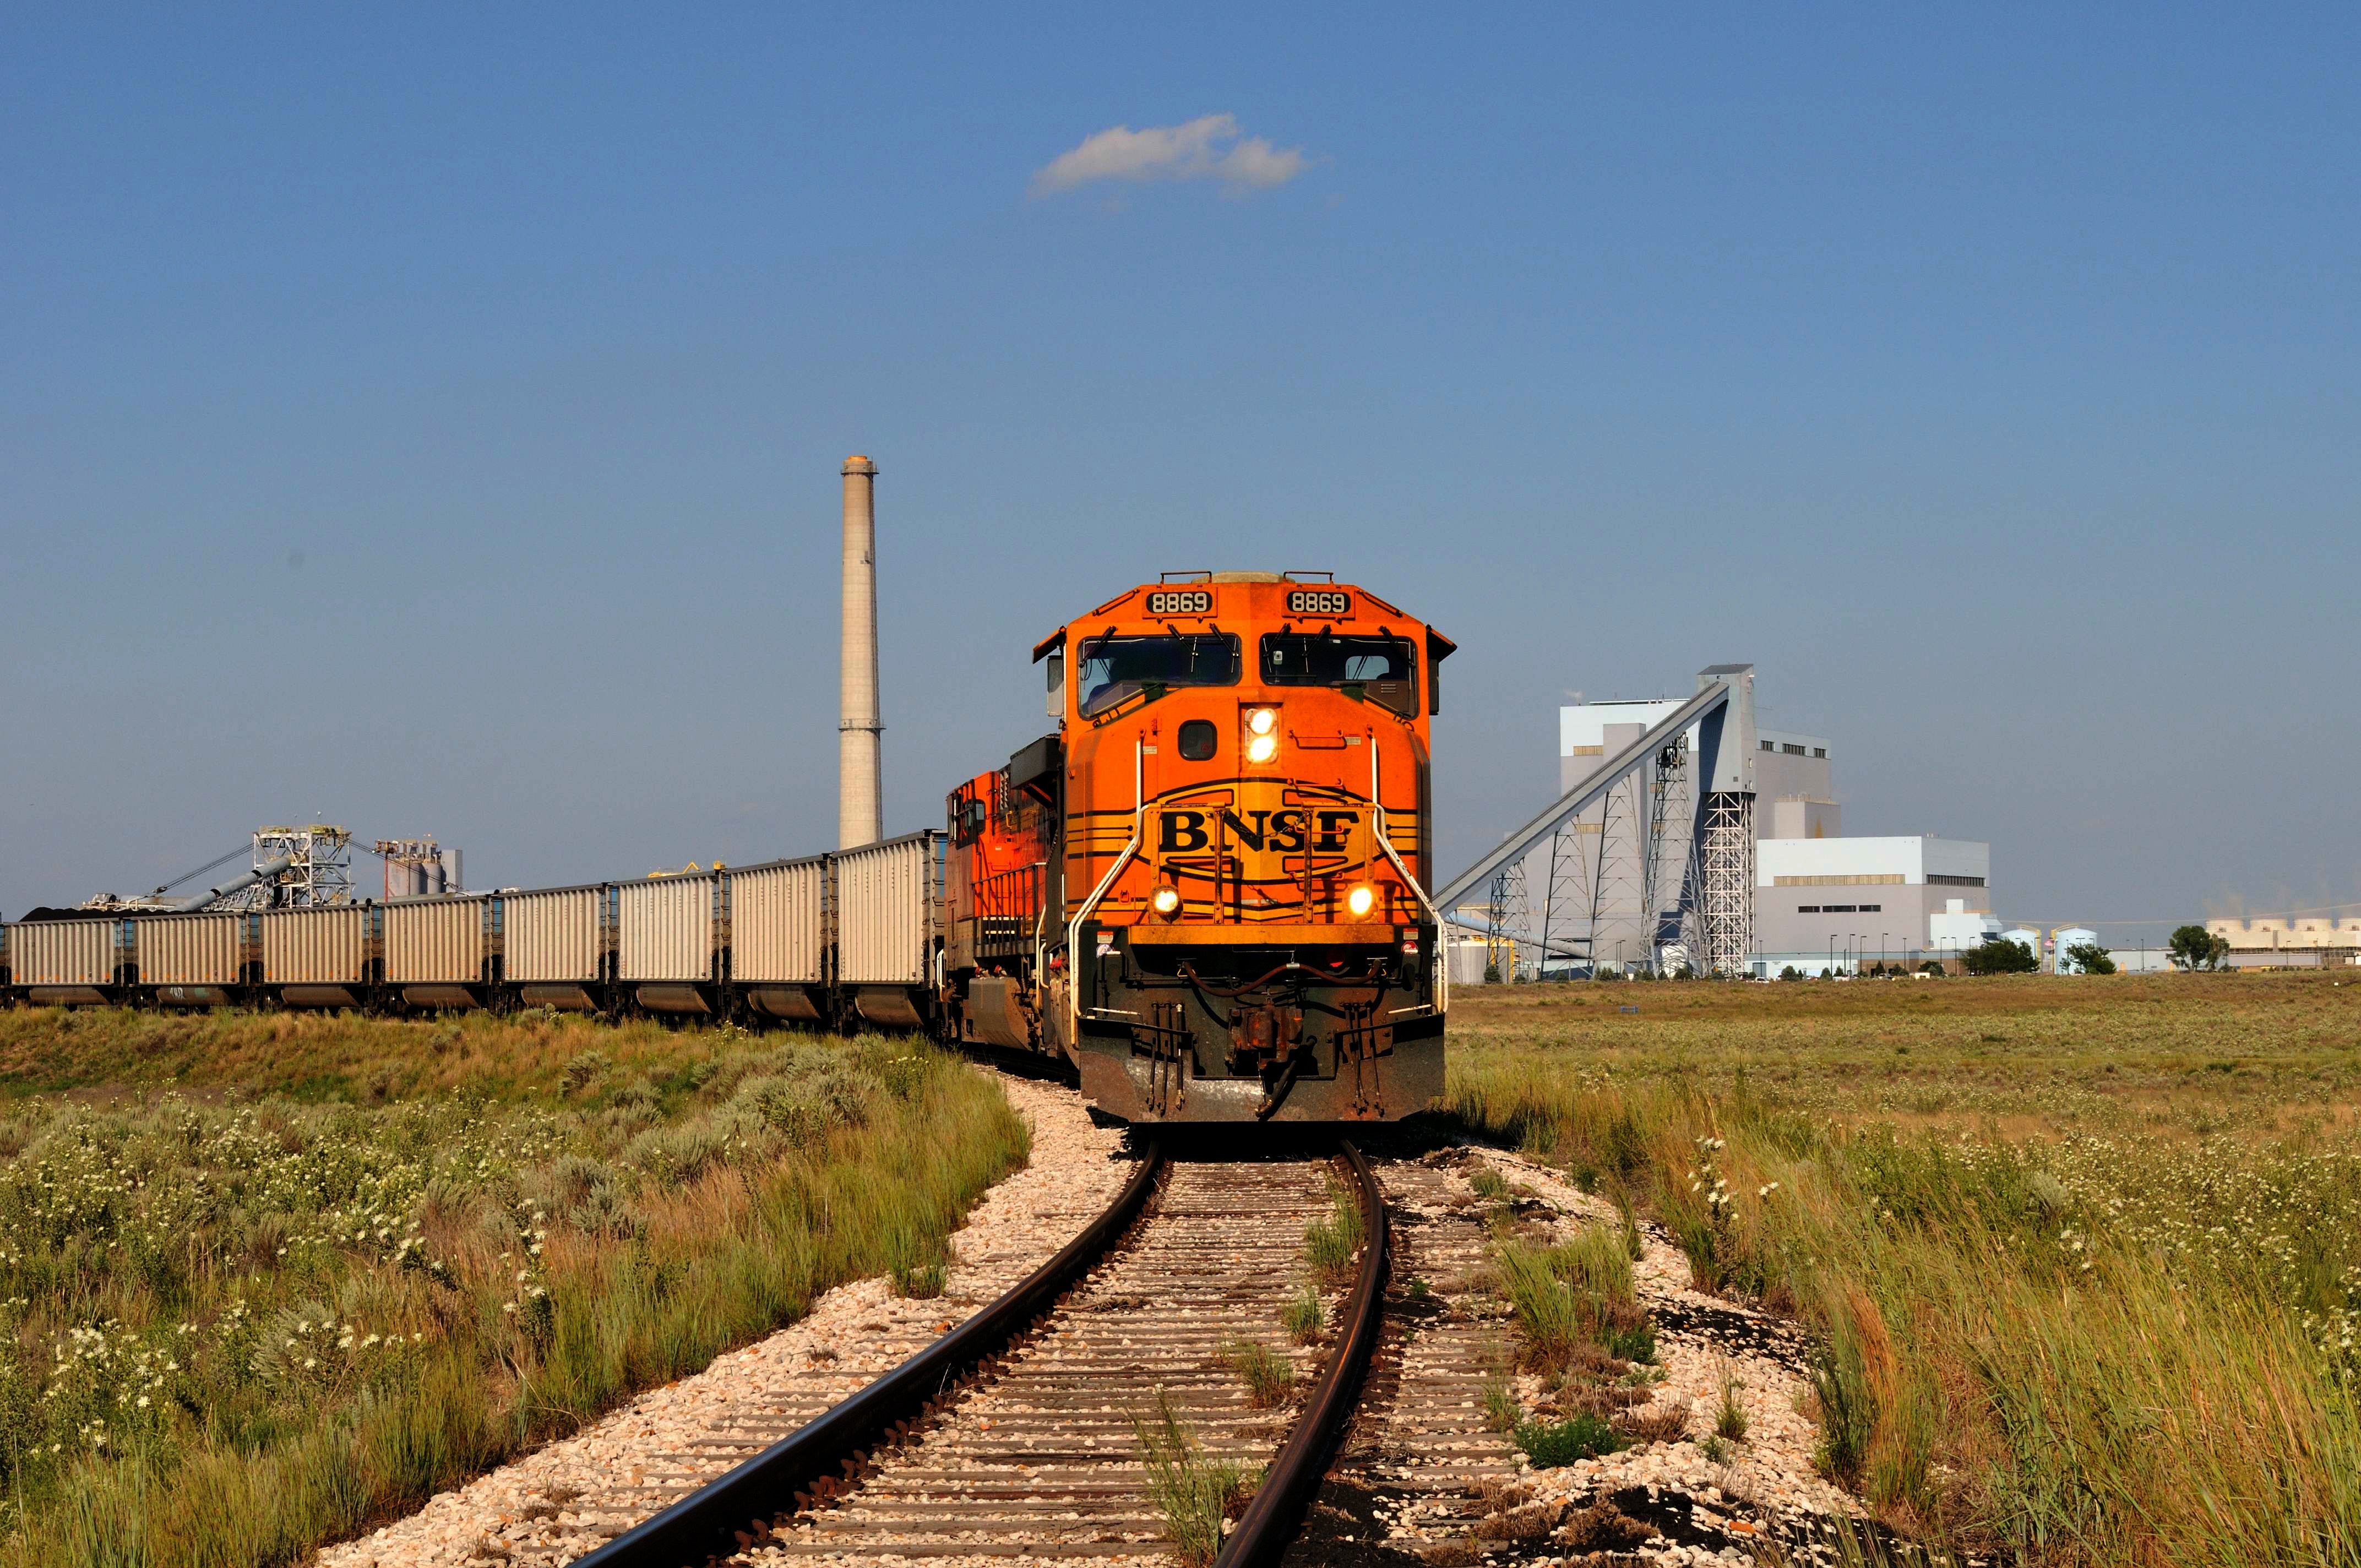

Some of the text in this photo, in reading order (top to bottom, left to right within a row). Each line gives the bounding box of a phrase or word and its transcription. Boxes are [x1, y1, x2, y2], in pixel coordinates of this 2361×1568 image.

[1152, 593, 1207, 612] 8869
[1292, 592, 1345, 612] 8869
[1158, 810, 1360, 852] BNSF
